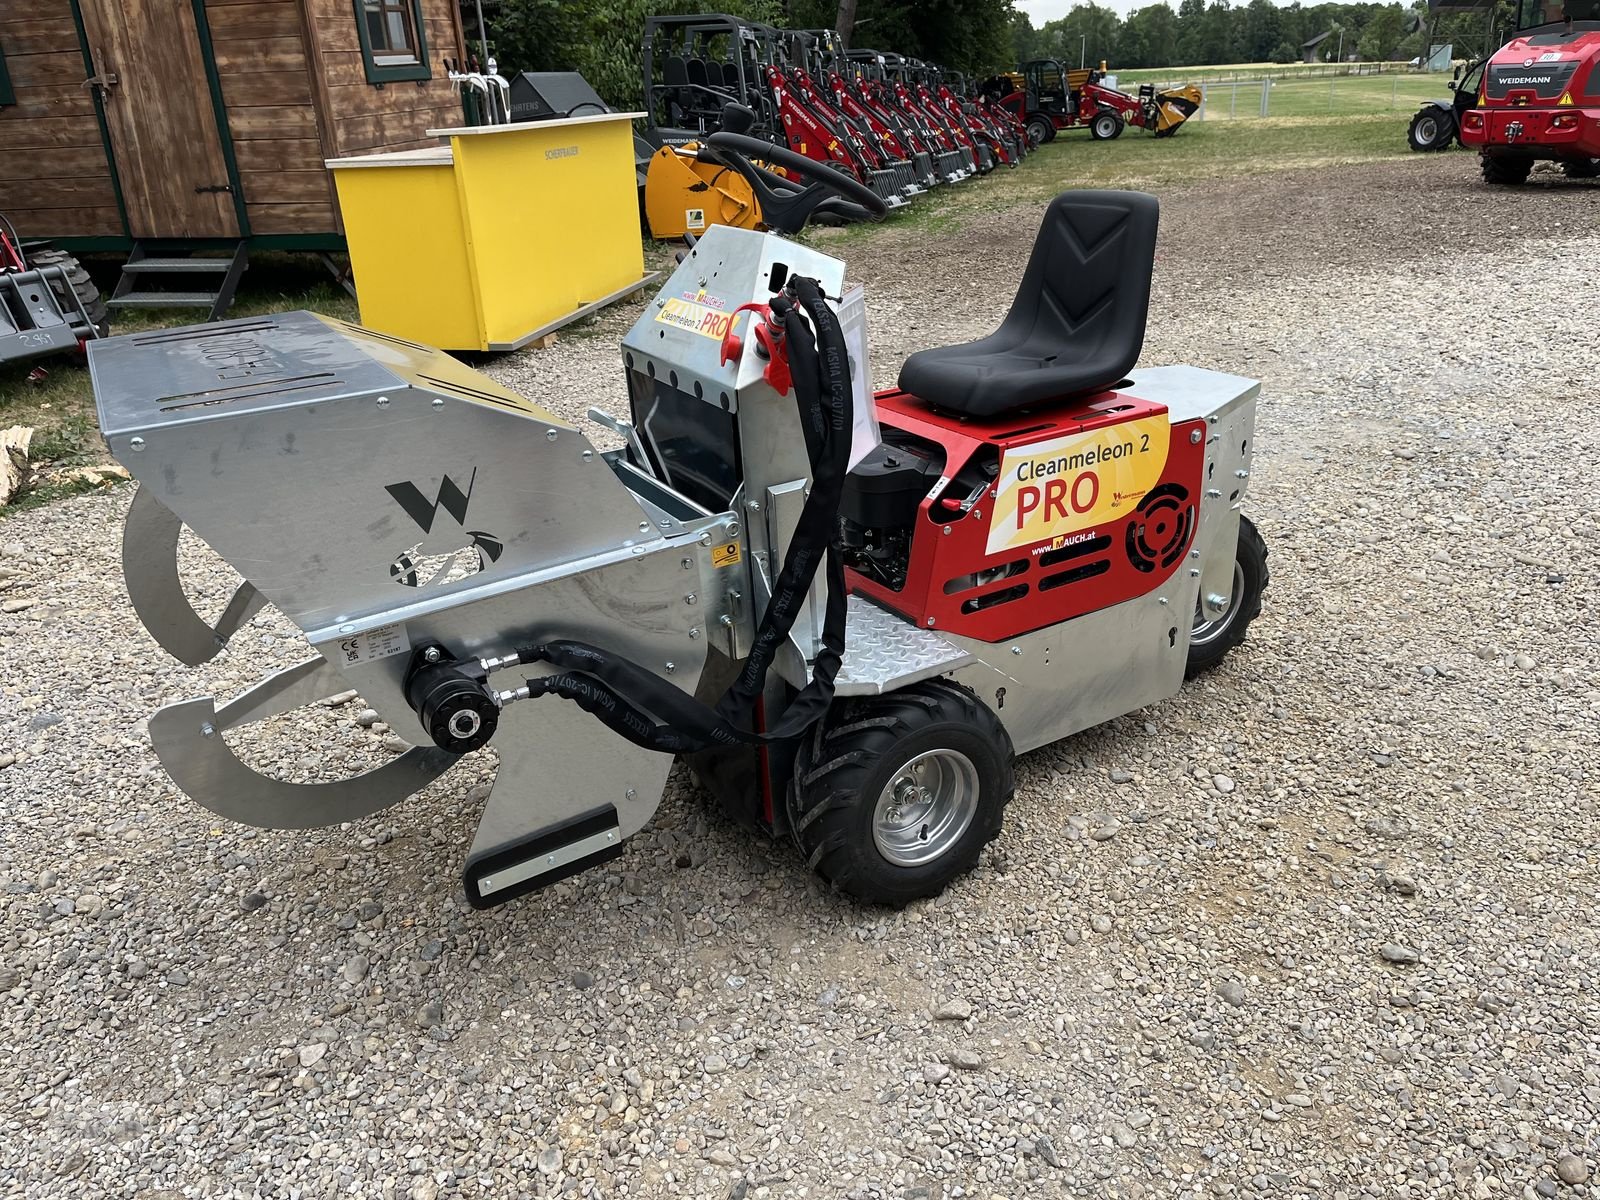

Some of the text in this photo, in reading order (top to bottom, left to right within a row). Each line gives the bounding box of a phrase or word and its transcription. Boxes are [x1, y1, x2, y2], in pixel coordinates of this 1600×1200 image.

[1498, 76, 1551, 85] WEIDEMANN
[788, 99, 818, 130] WEIDEMANN
[814, 99, 838, 123] WEIDEMA
[660, 310, 730, 336] Cleanmeleon 2 PRO
[825, 346, 841, 377] MSHA
[830, 379, 845, 431] IC-207/01
[1016, 433, 1150, 481] Cleanmeleon 2
[1016, 471, 1100, 530] PRO
[1031, 530, 1096, 556] www.MAUCH.at
[548, 675, 592, 698] IC-207/0
